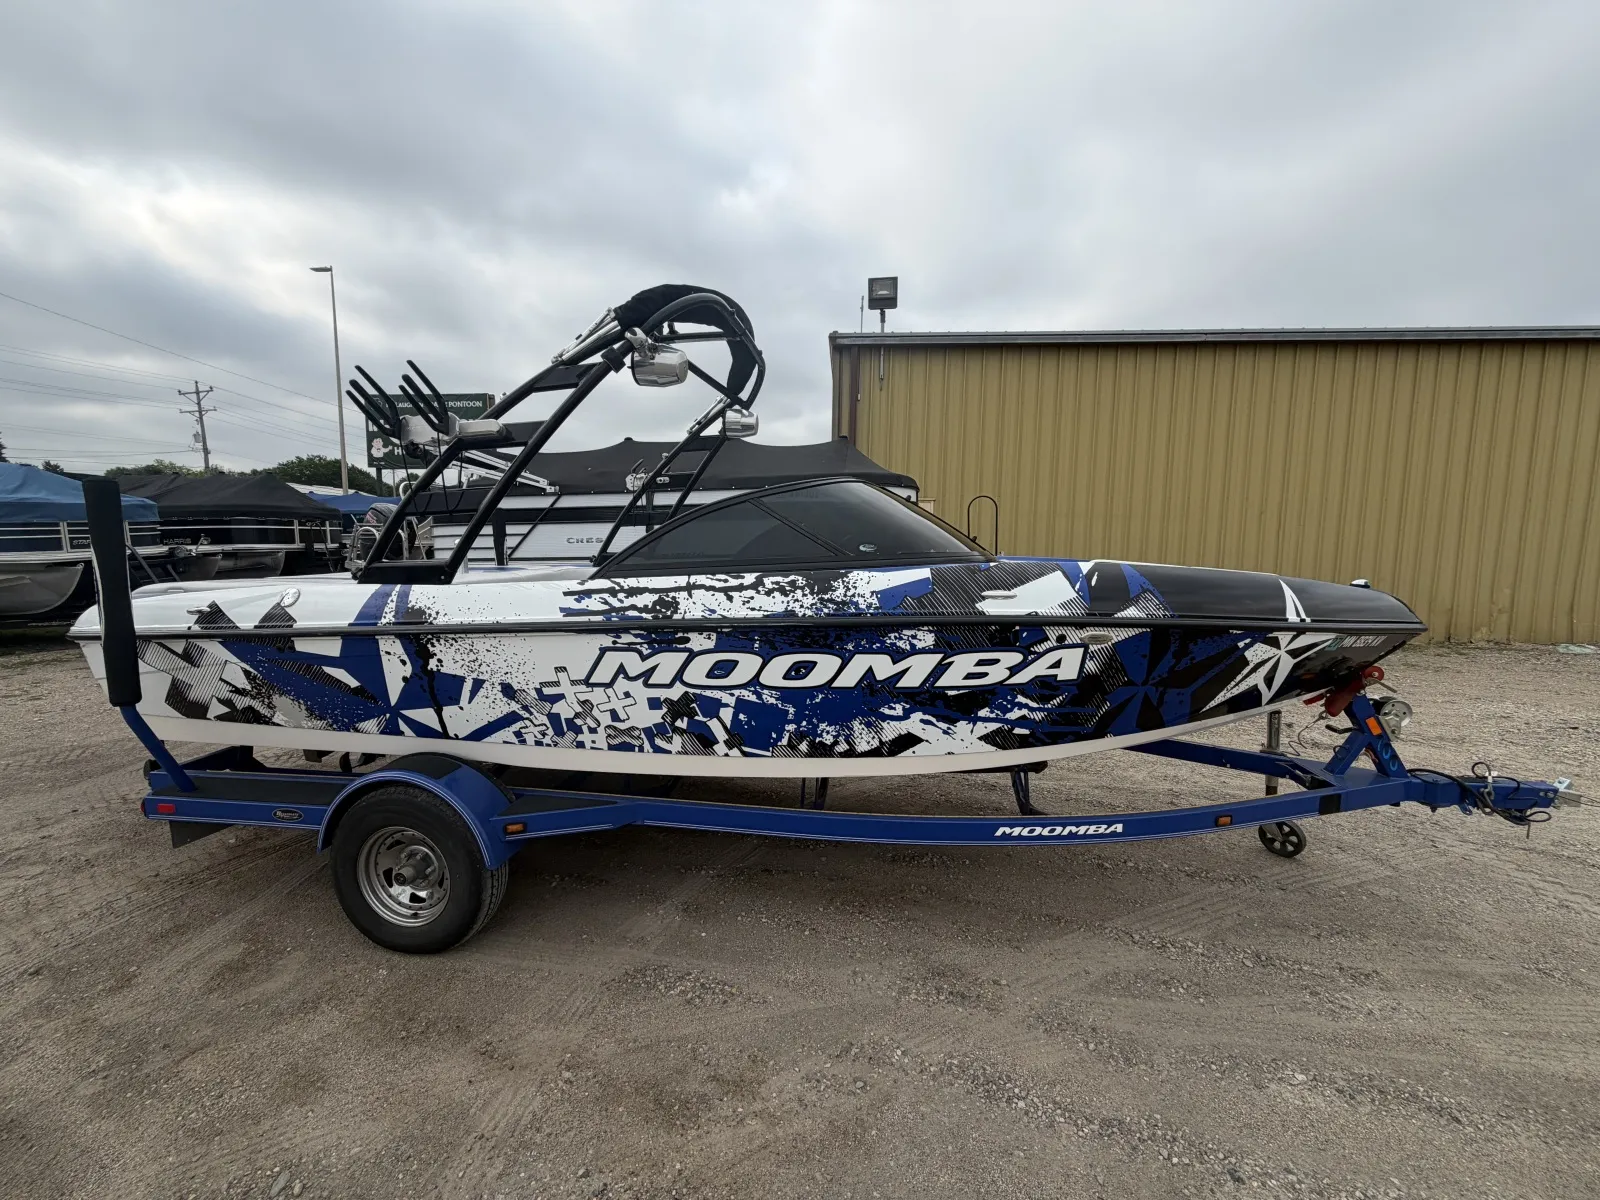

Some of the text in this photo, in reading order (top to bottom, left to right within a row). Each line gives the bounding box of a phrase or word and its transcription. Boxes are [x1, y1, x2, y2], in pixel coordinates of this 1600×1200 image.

[448, 400, 483, 408] PONTOON
[586, 646, 1086, 688] MOOMBA
[993, 823, 1123, 837] MOOMBA
